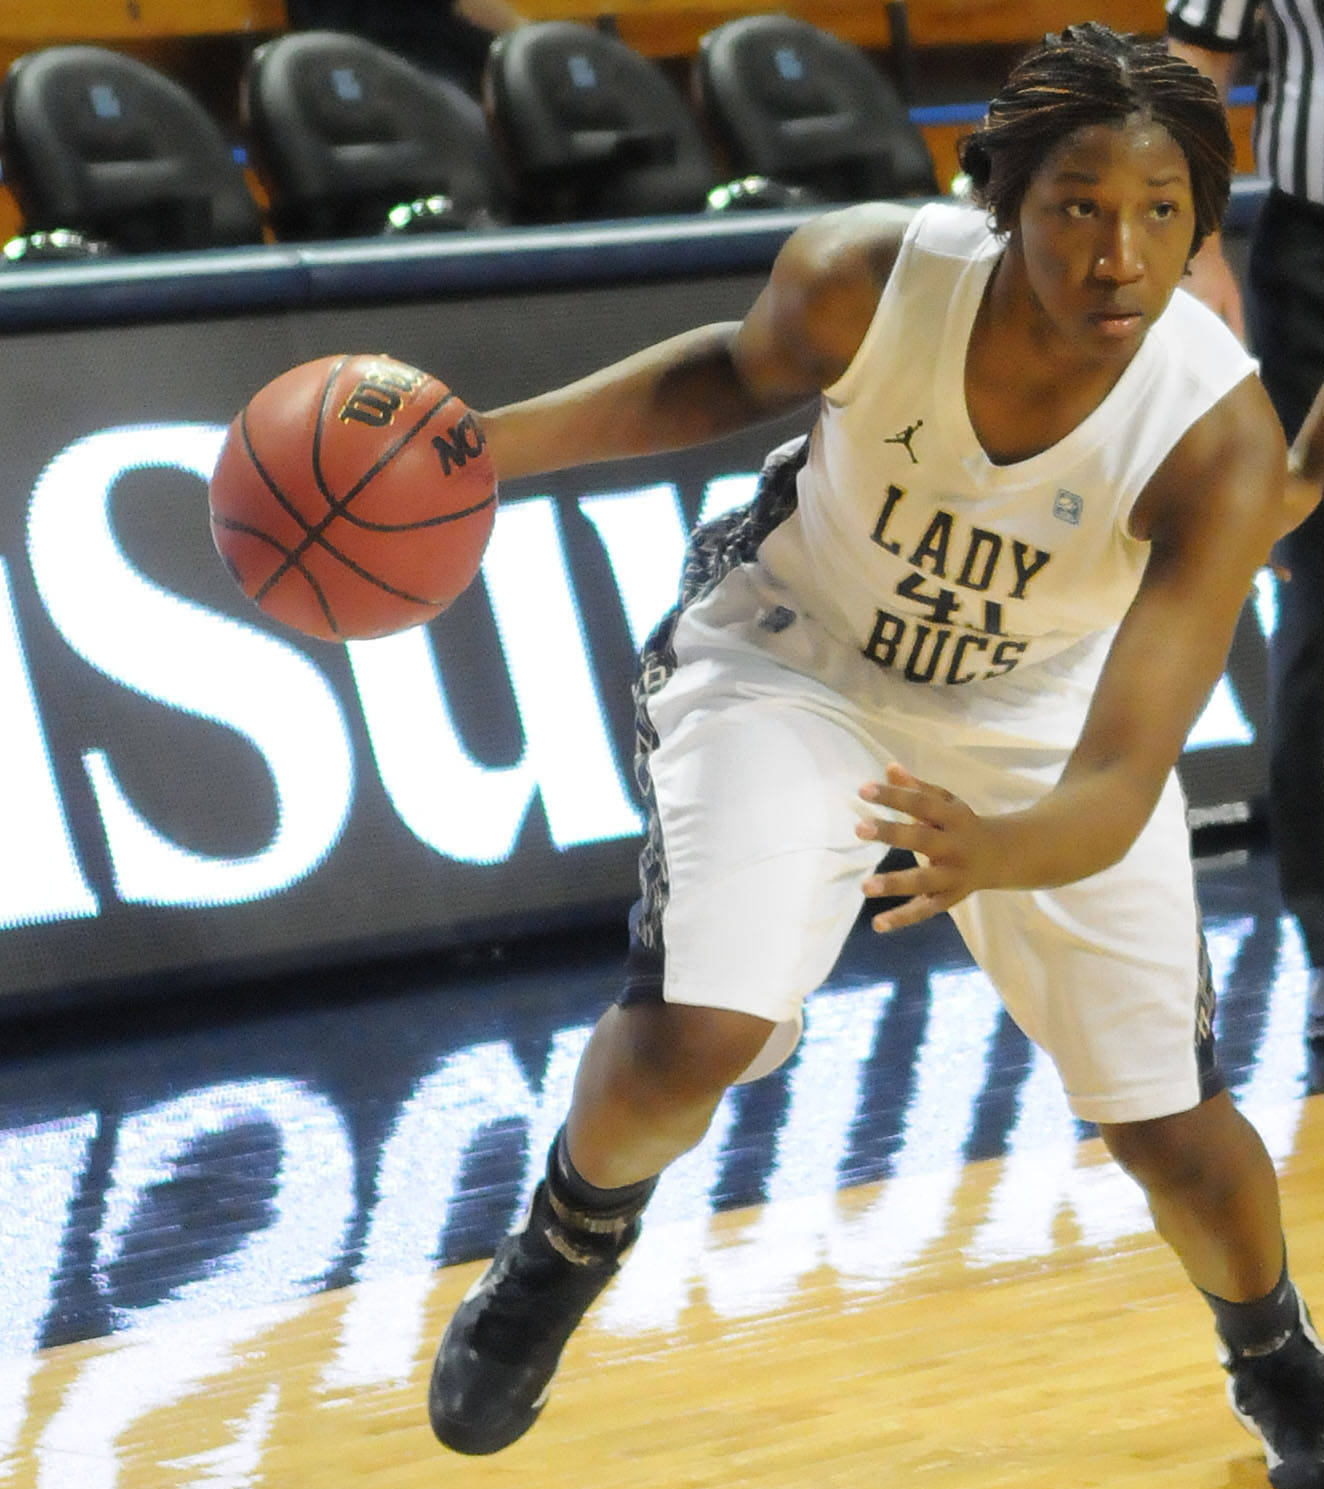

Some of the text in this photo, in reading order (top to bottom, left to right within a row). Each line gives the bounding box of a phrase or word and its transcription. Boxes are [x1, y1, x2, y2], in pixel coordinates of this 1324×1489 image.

[869, 484, 1051, 600] LADY
[896, 572, 1009, 638] 41
[863, 608, 1028, 686] BUCS
